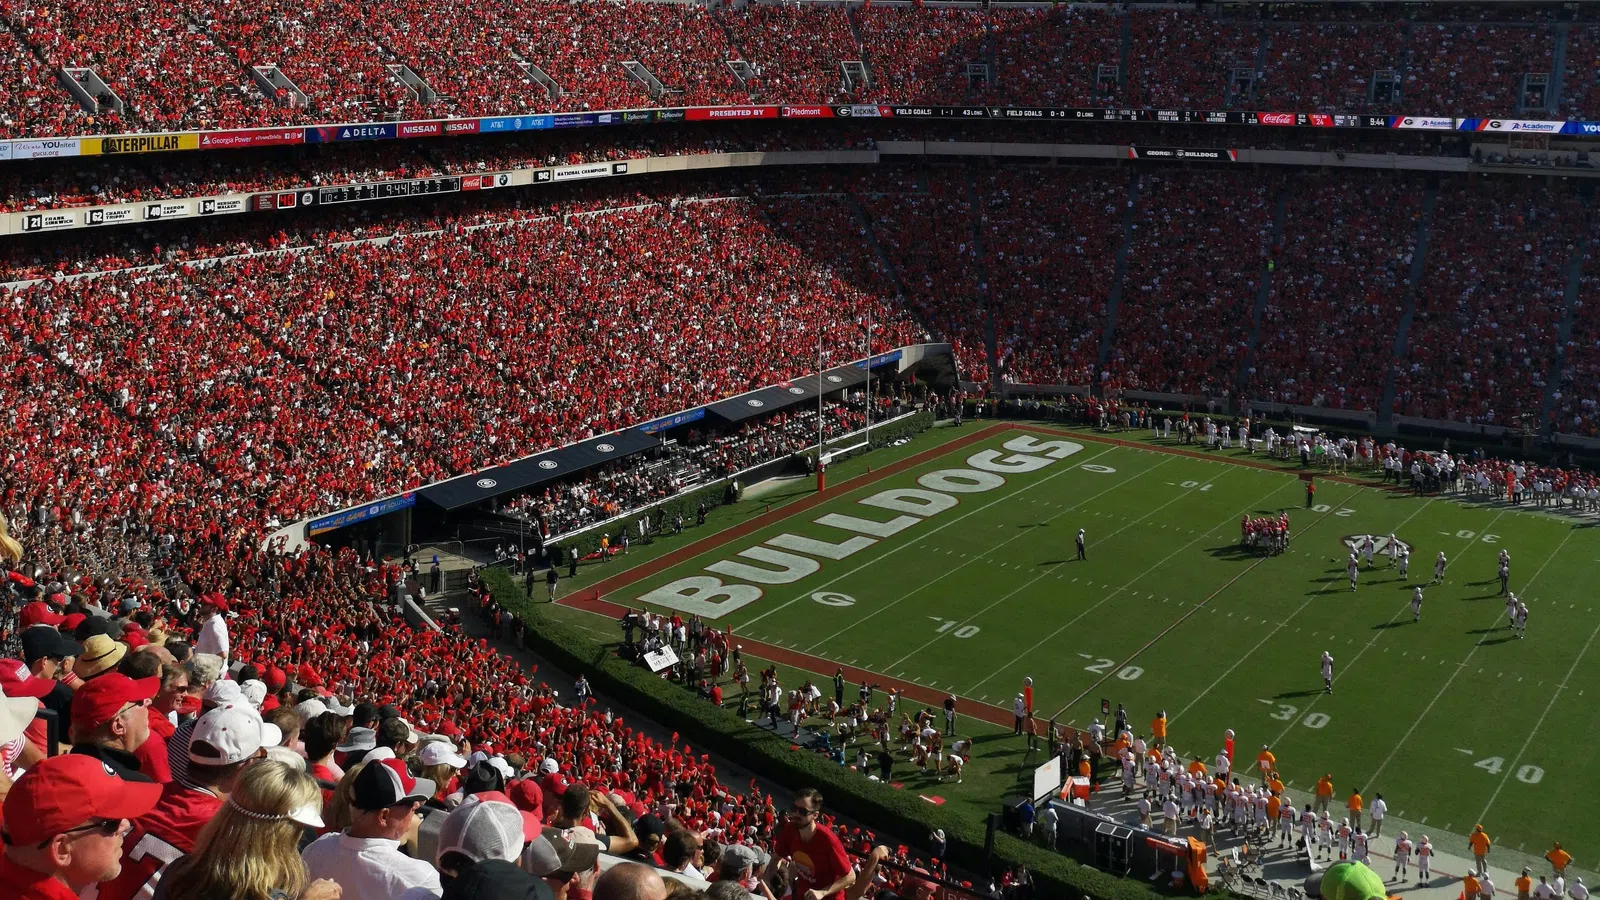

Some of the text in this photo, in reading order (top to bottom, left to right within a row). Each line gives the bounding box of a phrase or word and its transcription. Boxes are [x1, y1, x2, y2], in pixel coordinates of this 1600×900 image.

[709, 109, 752, 117] PRESENTED
[790, 107, 821, 115] Piedmont
[445, 122, 475, 131] NISSAN
[490, 120, 505, 129] AT&T
[531, 118, 545, 127] AT&T
[1369, 117, 1385, 126] 9:44
[1521, 122, 1555, 130] Academy
[353, 127, 386, 136] DELTA
[403, 124, 437, 134] NISSAN
[42, 140, 76, 150] YOUnited
[211, 137, 234, 145] Georgia
[234, 135, 252, 143] Power
[32, 149, 60, 158] gucu.org
[386, 183, 407, 195] 9:44
[325, 193, 332, 202] 10
[150, 206, 160, 216] 40
[204, 201, 215, 212] 34
[92, 211, 103, 222] 62
[30, 217, 41, 228] 21
[388, 496, 415, 509] SOLUTIONS
[636, 435, 1085, 620] BULLDOGS
[936, 620, 981, 639] 10
[1084, 658, 1145, 681] 20
[1270, 704, 1331, 729] 30
[1474, 756, 1545, 784] 40
